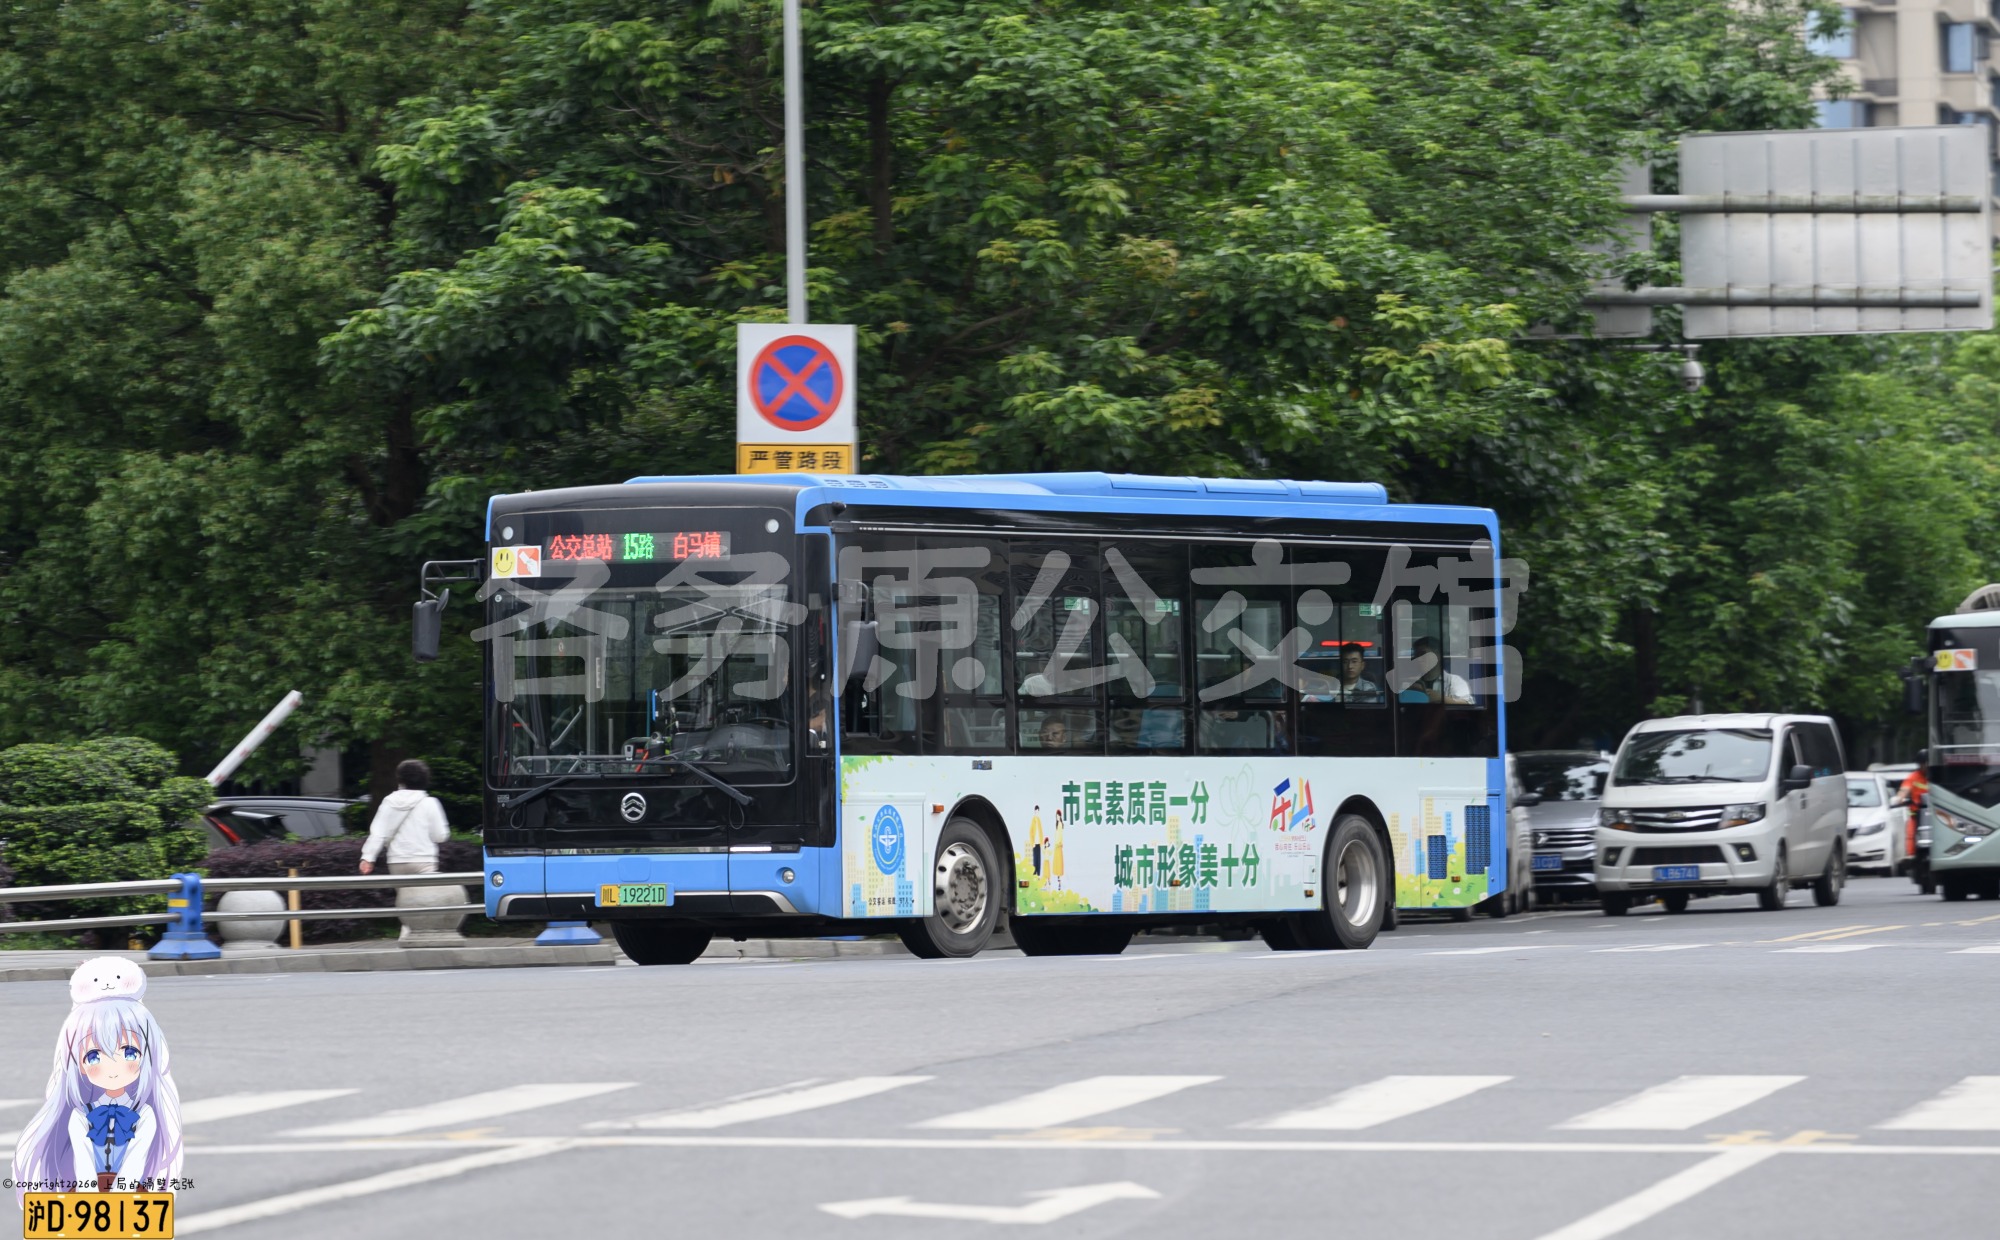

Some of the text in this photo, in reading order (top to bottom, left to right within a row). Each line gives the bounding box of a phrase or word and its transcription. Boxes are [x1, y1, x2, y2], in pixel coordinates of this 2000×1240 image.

[747, 450, 842, 470] 严管路段
[549, 532, 721, 560] 公交总站 15路 白马镇
[1061, 780, 1210, 826] 市民素质高一分
[1114, 842, 1260, 889] 城市形象美十分
